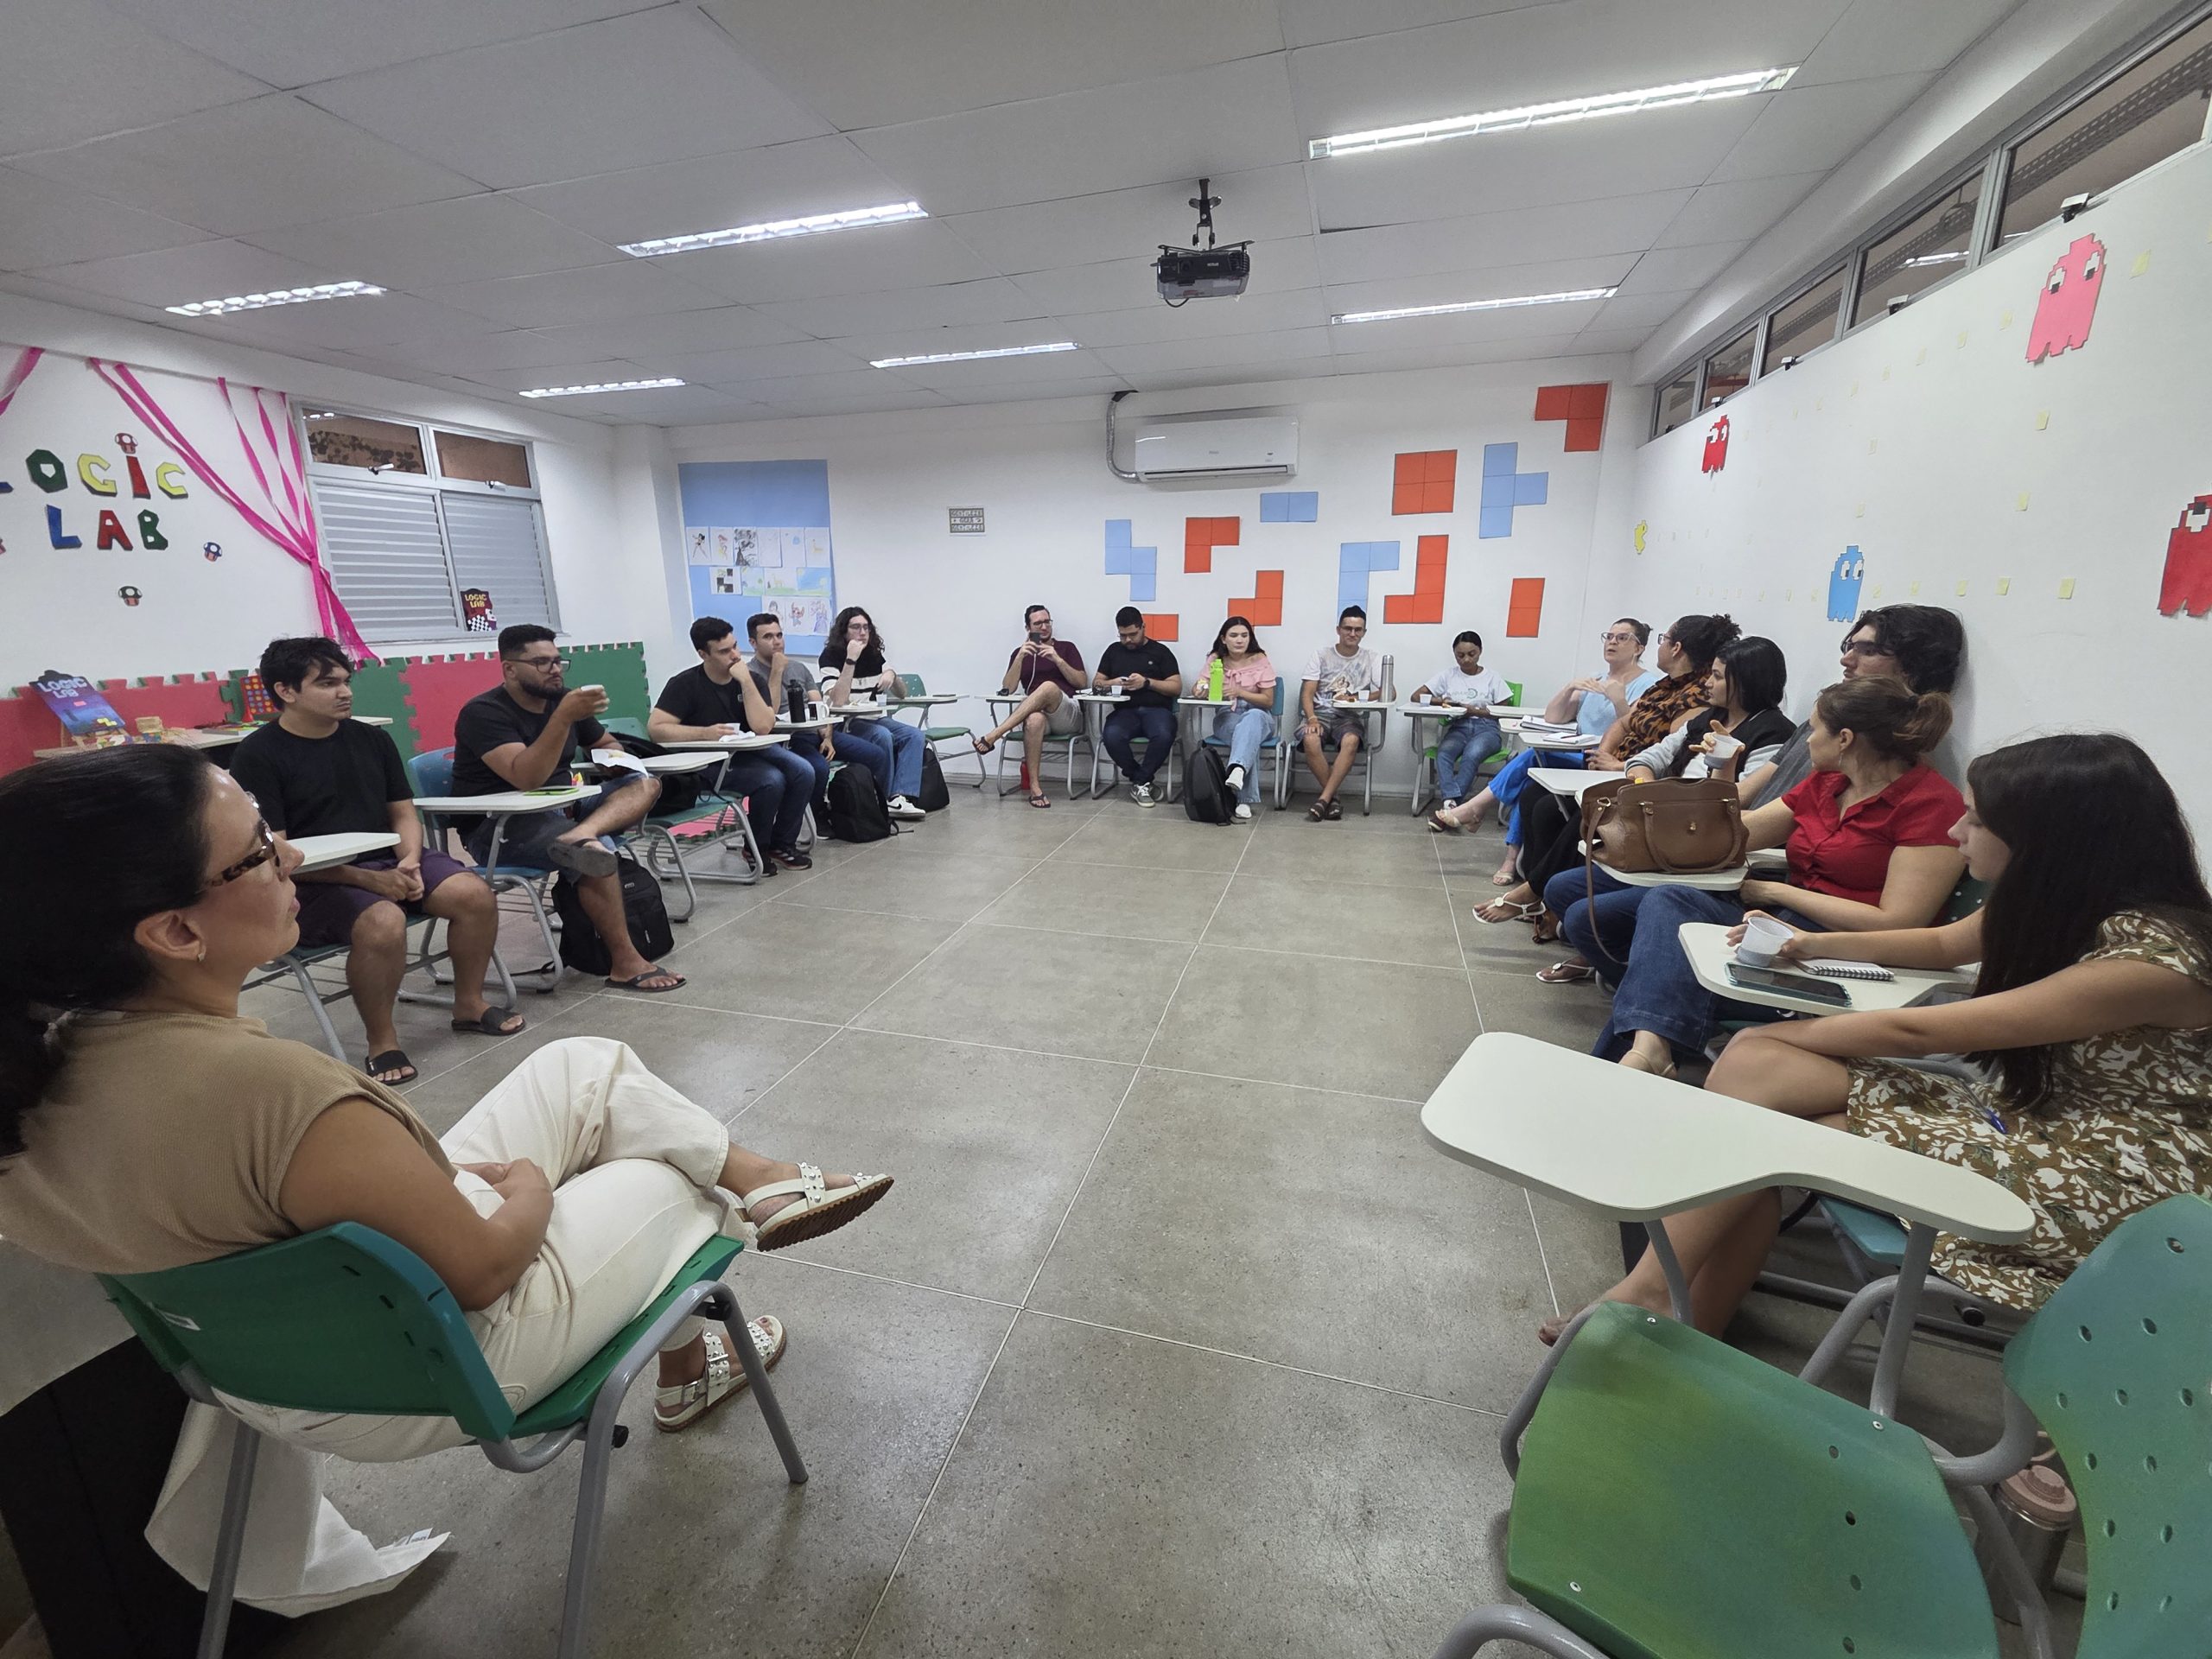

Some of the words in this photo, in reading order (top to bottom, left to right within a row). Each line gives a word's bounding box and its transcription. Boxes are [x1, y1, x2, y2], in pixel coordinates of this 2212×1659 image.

[0, 448, 188, 499] OGIC
[45, 504, 168, 550] LAB
[37, 677, 87, 692] LOGIC
